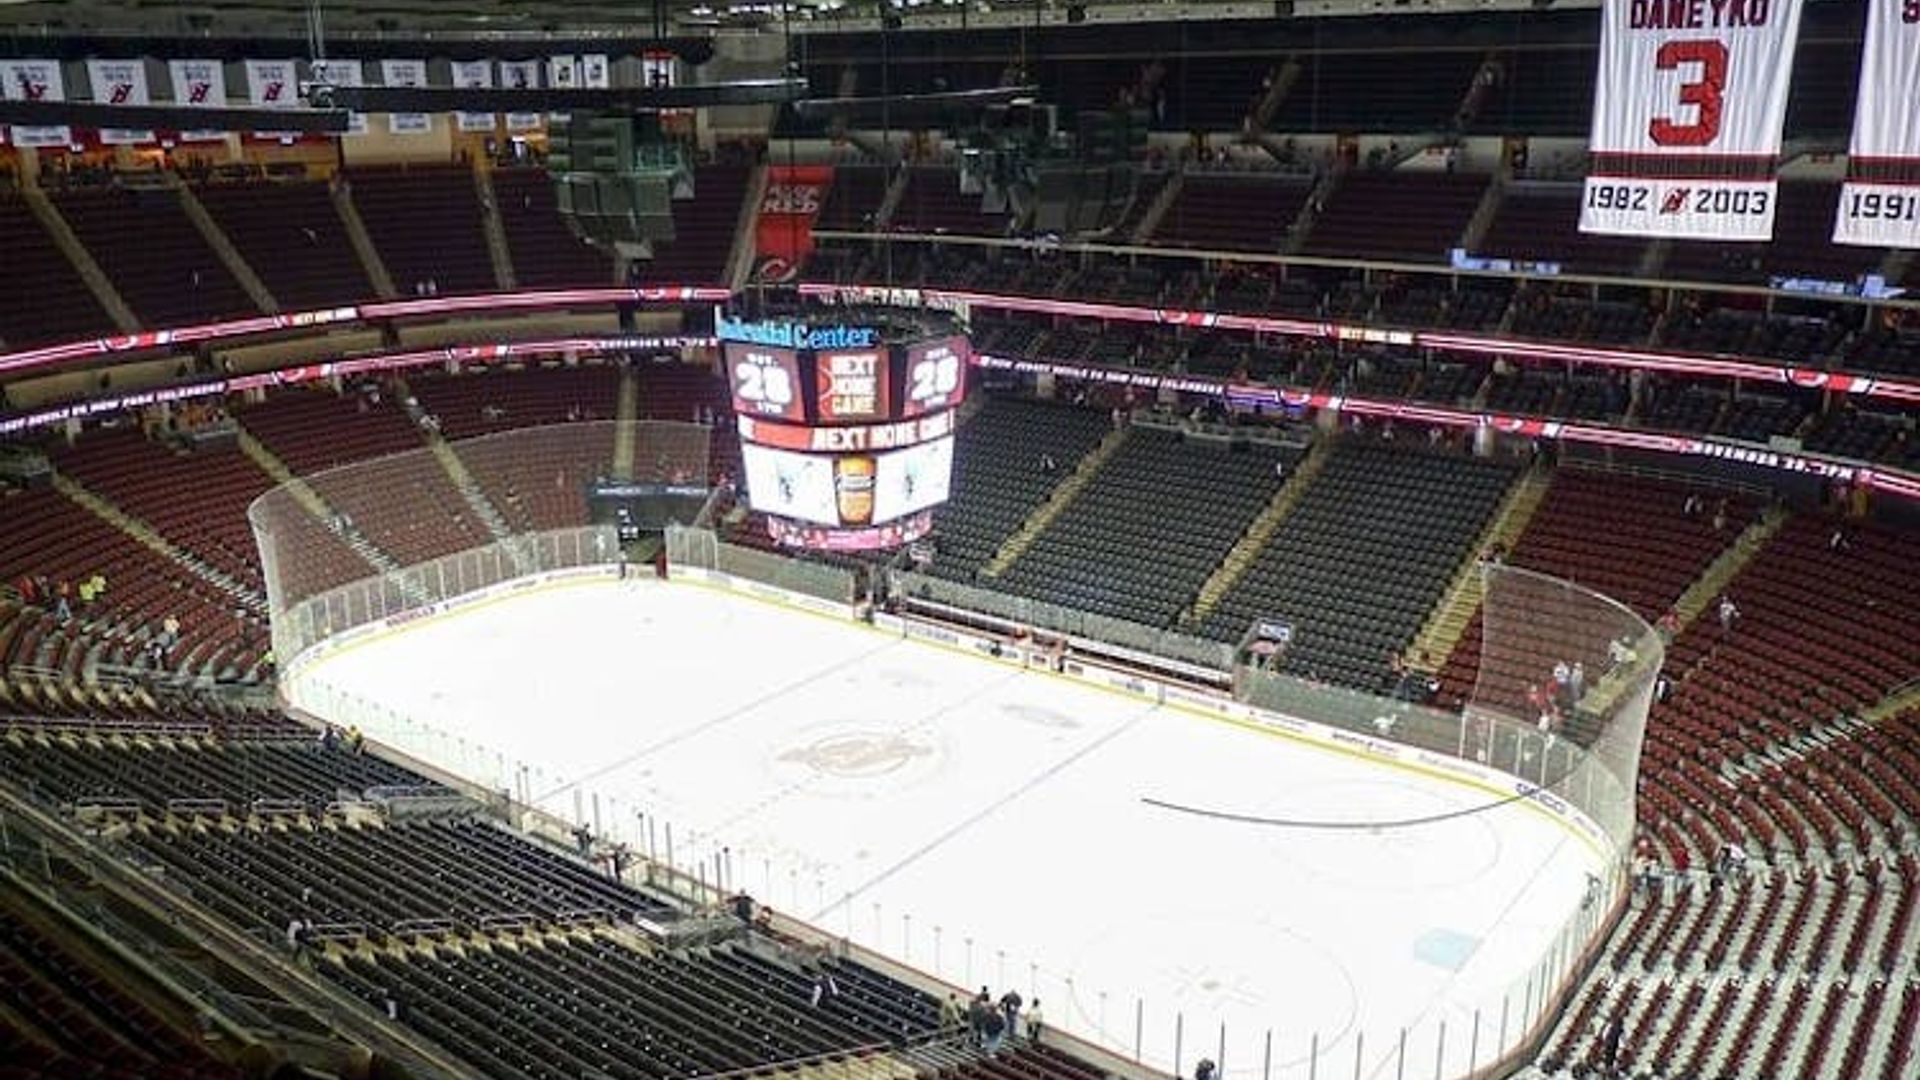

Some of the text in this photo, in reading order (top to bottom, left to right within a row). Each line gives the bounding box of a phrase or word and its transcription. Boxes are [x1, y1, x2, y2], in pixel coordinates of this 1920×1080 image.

[1631, 0, 1768, 29] DANEYKO
[1649, 40, 1728, 146] 3
[1587, 186, 1768, 215] 1982 2003
[1850, 193, 1914, 220] 1991
[794, 324, 877, 349] Center
[737, 363, 792, 404] 28
[912, 356, 959, 401] 28
[811, 426, 868, 451] NEXT
